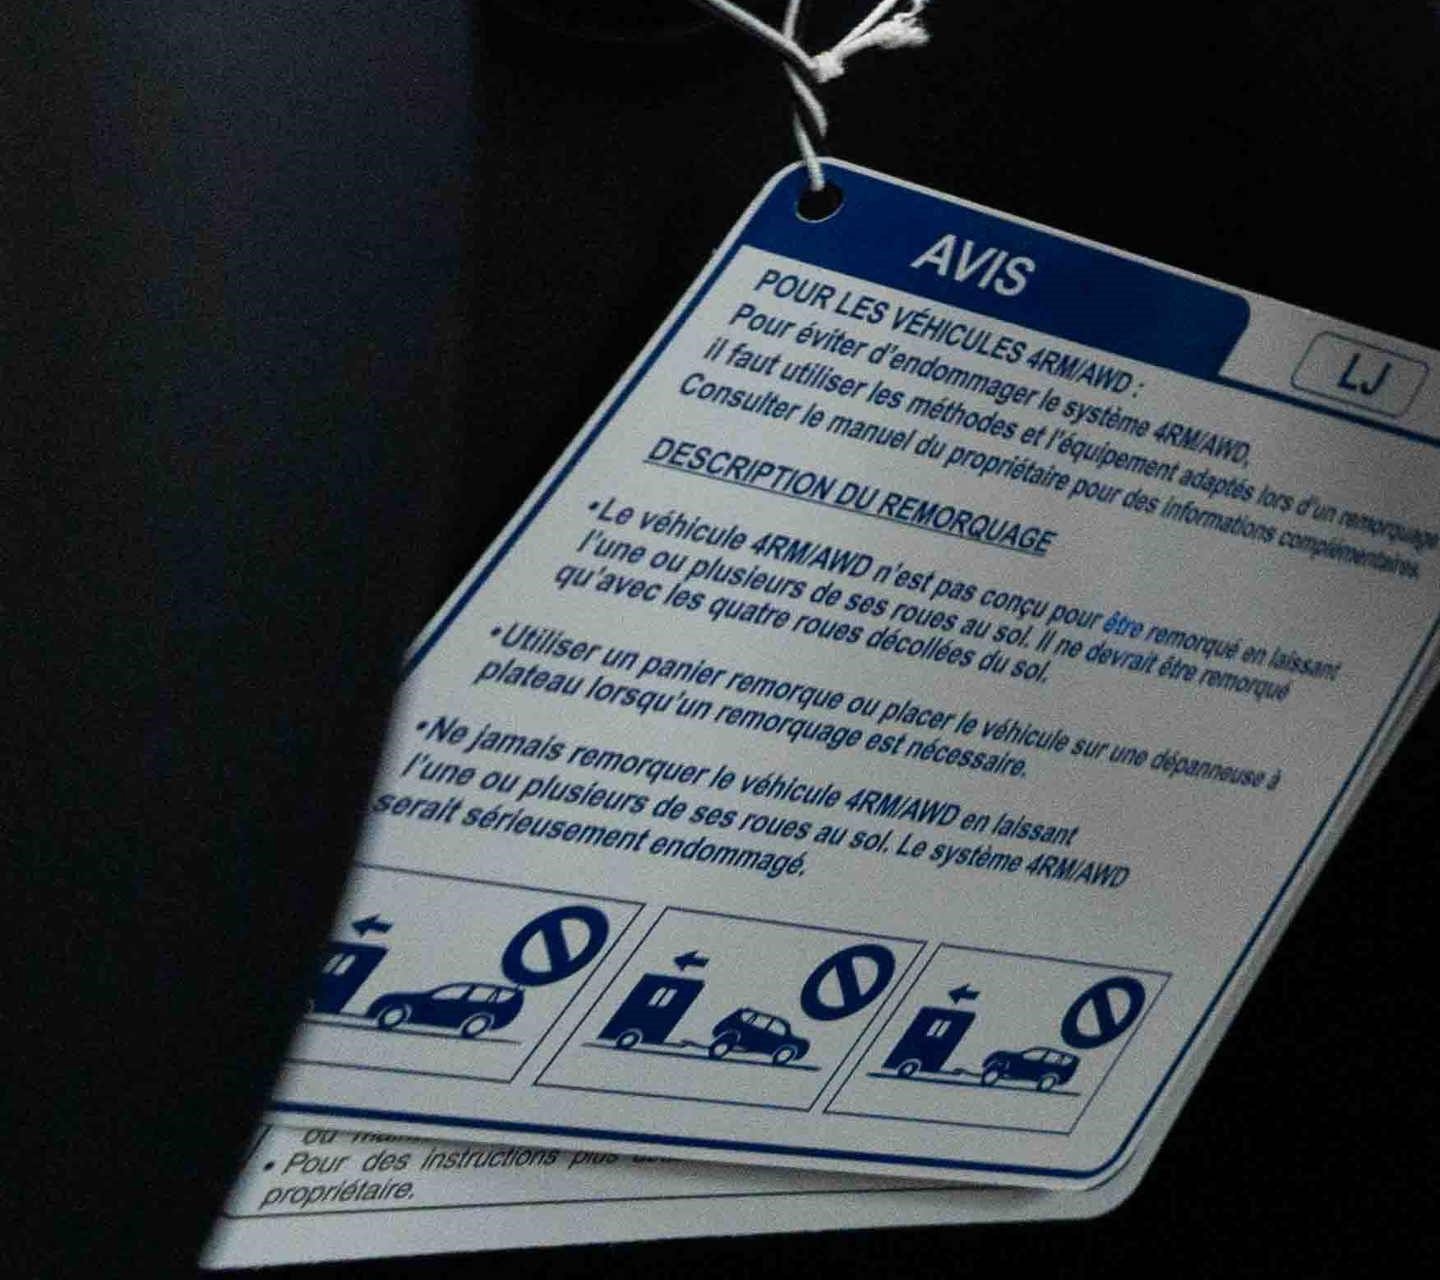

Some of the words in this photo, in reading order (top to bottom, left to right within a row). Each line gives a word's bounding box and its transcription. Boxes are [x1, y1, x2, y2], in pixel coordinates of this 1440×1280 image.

[910, 234, 1036, 296] AVIS
[729, 302, 796, 338] Pour
[796, 321, 869, 359] éviter
[868, 342, 1040, 409] d'endommager
[1039, 386, 1061, 412] le
[1062, 397, 1151, 440] système
[755, 269, 835, 310] POUR
[835, 289, 891, 324] LES
[890, 303, 1028, 363] VÉHICULES
[1026, 346, 1134, 394] 4RM/AWD
[1337, 352, 1393, 396] LJ
[643, 435, 832, 499] DESCRIPTION
[835, 481, 882, 510] DU
[878, 490, 1059, 552] REMORQUAGE
[679, 372, 801, 422] Consulter
[800, 401, 825, 428] le
[826, 412, 914, 453] manuel
[914, 432, 946, 458] du
[945, 440, 1070, 493] propriétaire
[1071, 471, 1121, 503] pour
[1122, 484, 1161, 514] des
[1160, 495, 1278, 544] informations
[554, 562, 663, 602] qu'avec
[663, 582, 706, 612] les
[707, 596, 791, 633] quatre
[790, 613, 865, 644] roues
[865, 624, 976, 670] décollées
[976, 649, 1007, 675] du
[1009, 656, 1050, 685] sol.
[638, 507, 747, 552] véhicule
[749, 531, 874, 580] 4RM/AWD
[872, 561, 935, 595] n'est
[933, 576, 979, 606] pas
[979, 586, 1049, 621] conçu
[1048, 603, 1103, 633] pour
[1102, 610, 1144, 640] être
[1144, 623, 1243, 664] remorqué
[1242, 640, 1269, 664] en
[473, 660, 584, 697] plateau
[584, 676, 714, 722] lorsqu'un
[713, 704, 863, 752] remorquage
[864, 734, 906, 758] est
[904, 740, 1028, 780] nécessaire.
[501, 621, 603, 664] Utiliser
[601, 646, 639, 670] un
[637, 656, 727, 690] panier
[725, 670, 847, 713] remorque
[845, 693, 882, 718] ou
[878, 699, 957, 732] placer
[958, 709, 982, 737] le
[981, 715, 1070, 754] véhicule
[1068, 739, 1109, 760] sur
[1107, 746, 1149, 769] une
[370, 790, 462, 826] serait
[460, 807, 646, 853] sérieusement
[648, 836, 808, 879] endommagé.
[466, 723, 566, 763] jamais
[566, 742, 710, 791] remorquer
[709, 764, 738, 791] le
[739, 772, 842, 810] véhicule
[844, 786, 961, 829] 4RM/AWD
[959, 811, 989, 834] en
[994, 813, 1081, 848] laissant
[258, 1180, 417, 1210] propriétaire.
[281, 1152, 353, 1176] Pour
[361, 1148, 410, 1174] des
[420, 1146, 560, 1171] instructions
